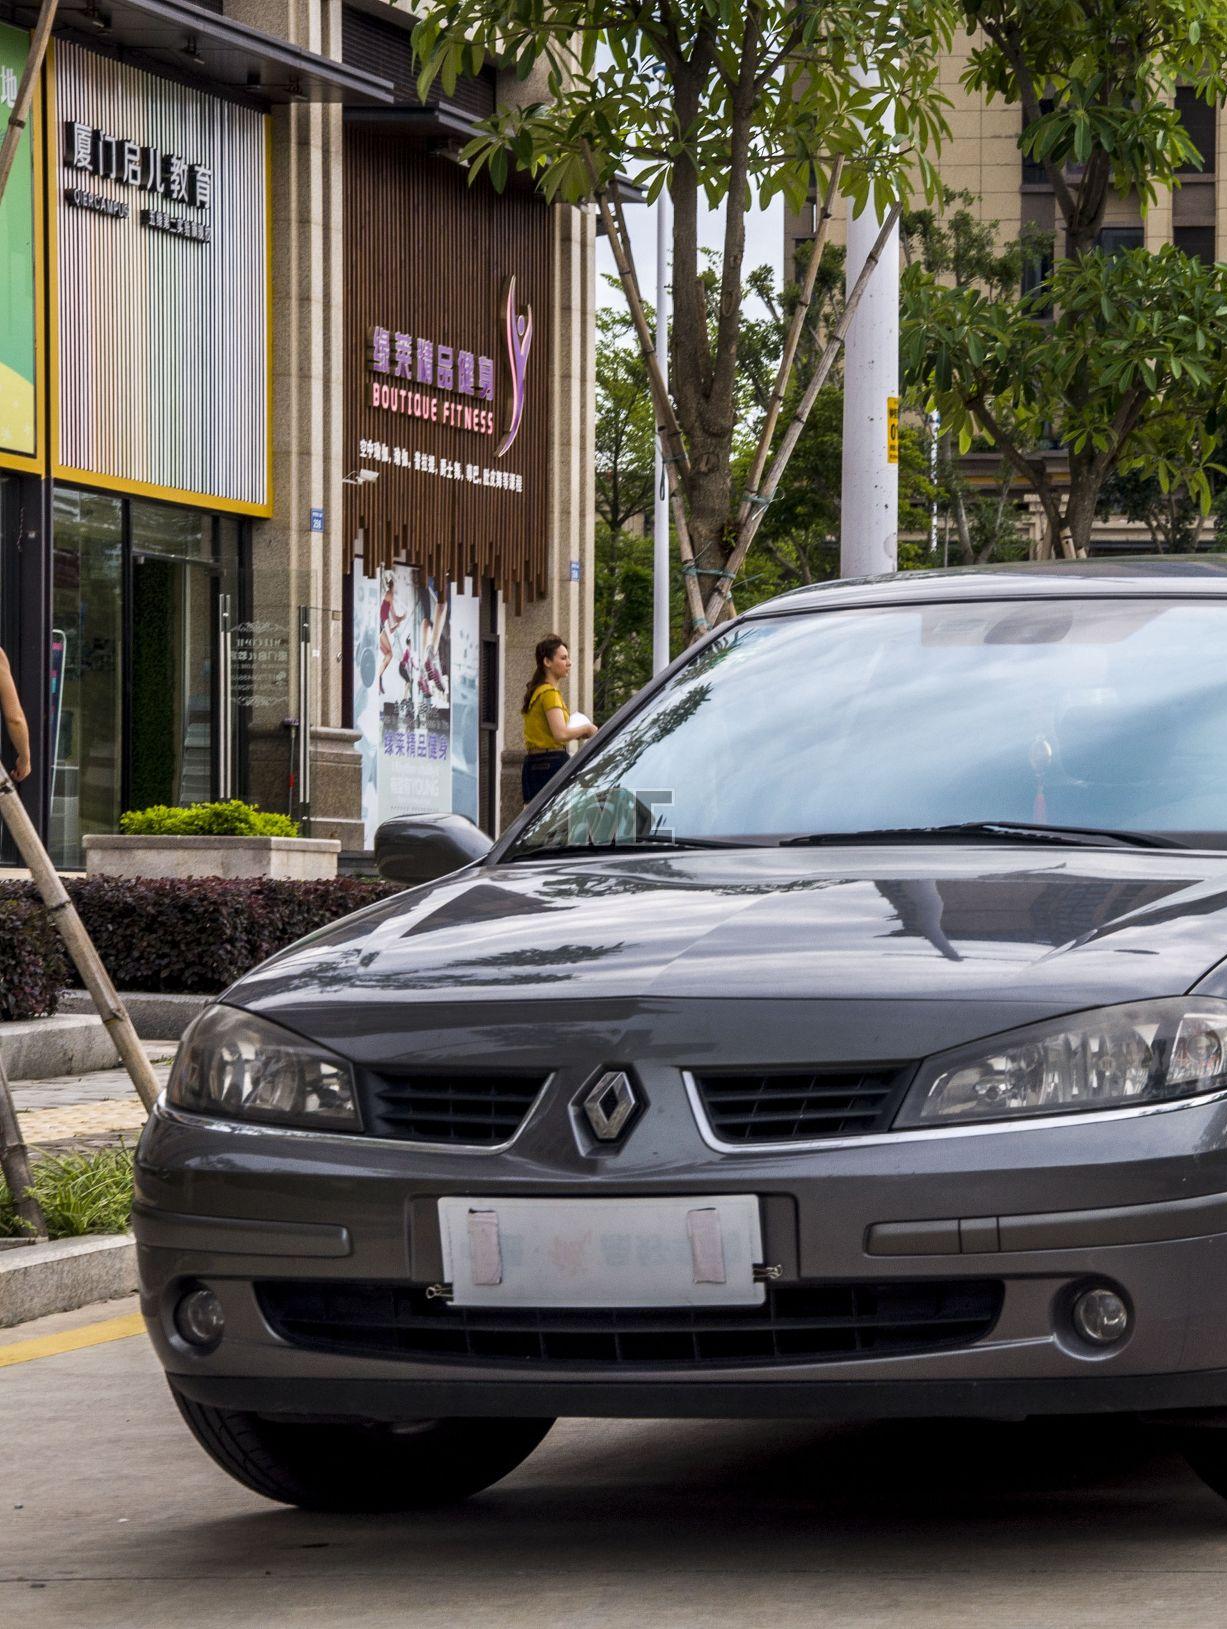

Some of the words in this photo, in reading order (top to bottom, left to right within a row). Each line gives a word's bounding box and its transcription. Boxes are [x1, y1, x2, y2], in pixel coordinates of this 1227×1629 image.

[72, 122, 212, 209] 厦门启儿教育
[372, 382, 437, 422] BOUTIQUE
[442, 401, 494, 435] FITNESS
